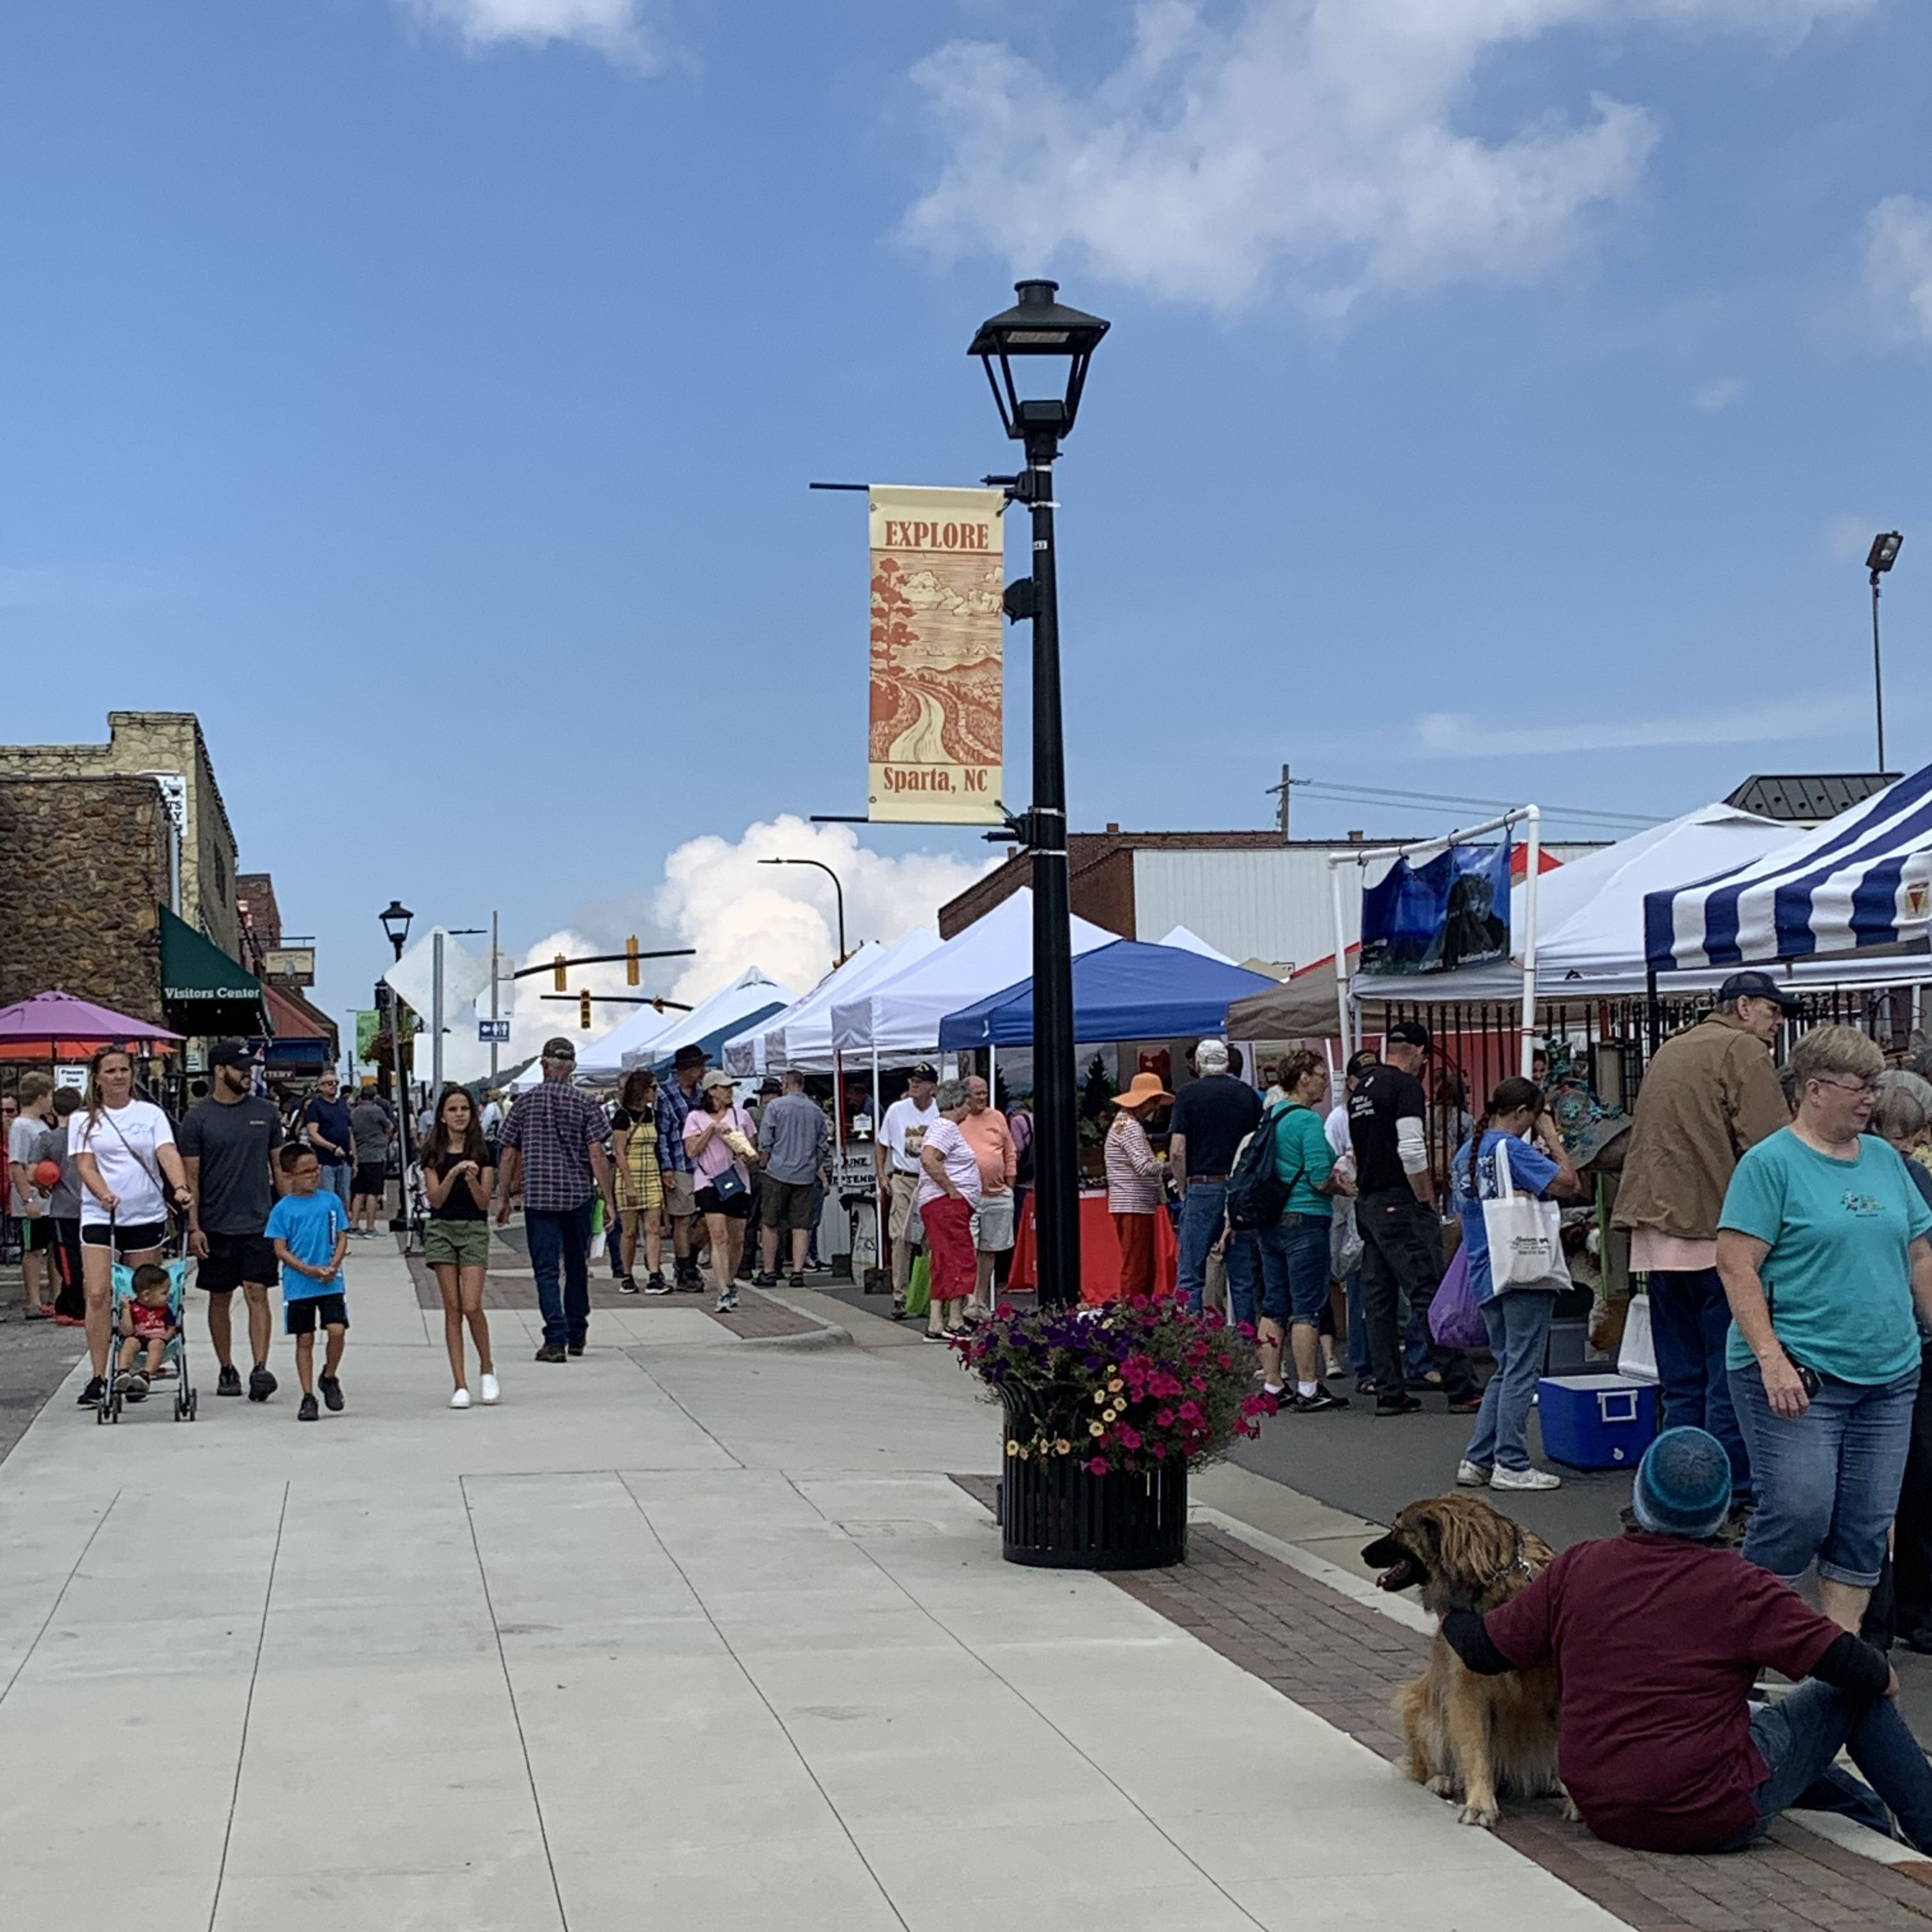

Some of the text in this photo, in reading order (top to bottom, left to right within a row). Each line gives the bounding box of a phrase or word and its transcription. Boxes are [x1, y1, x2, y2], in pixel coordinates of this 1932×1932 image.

[885, 521, 988, 549] EXPLORE
[884, 767, 987, 794] Sparta, NC
[164, 987, 260, 999] Visitors Center
